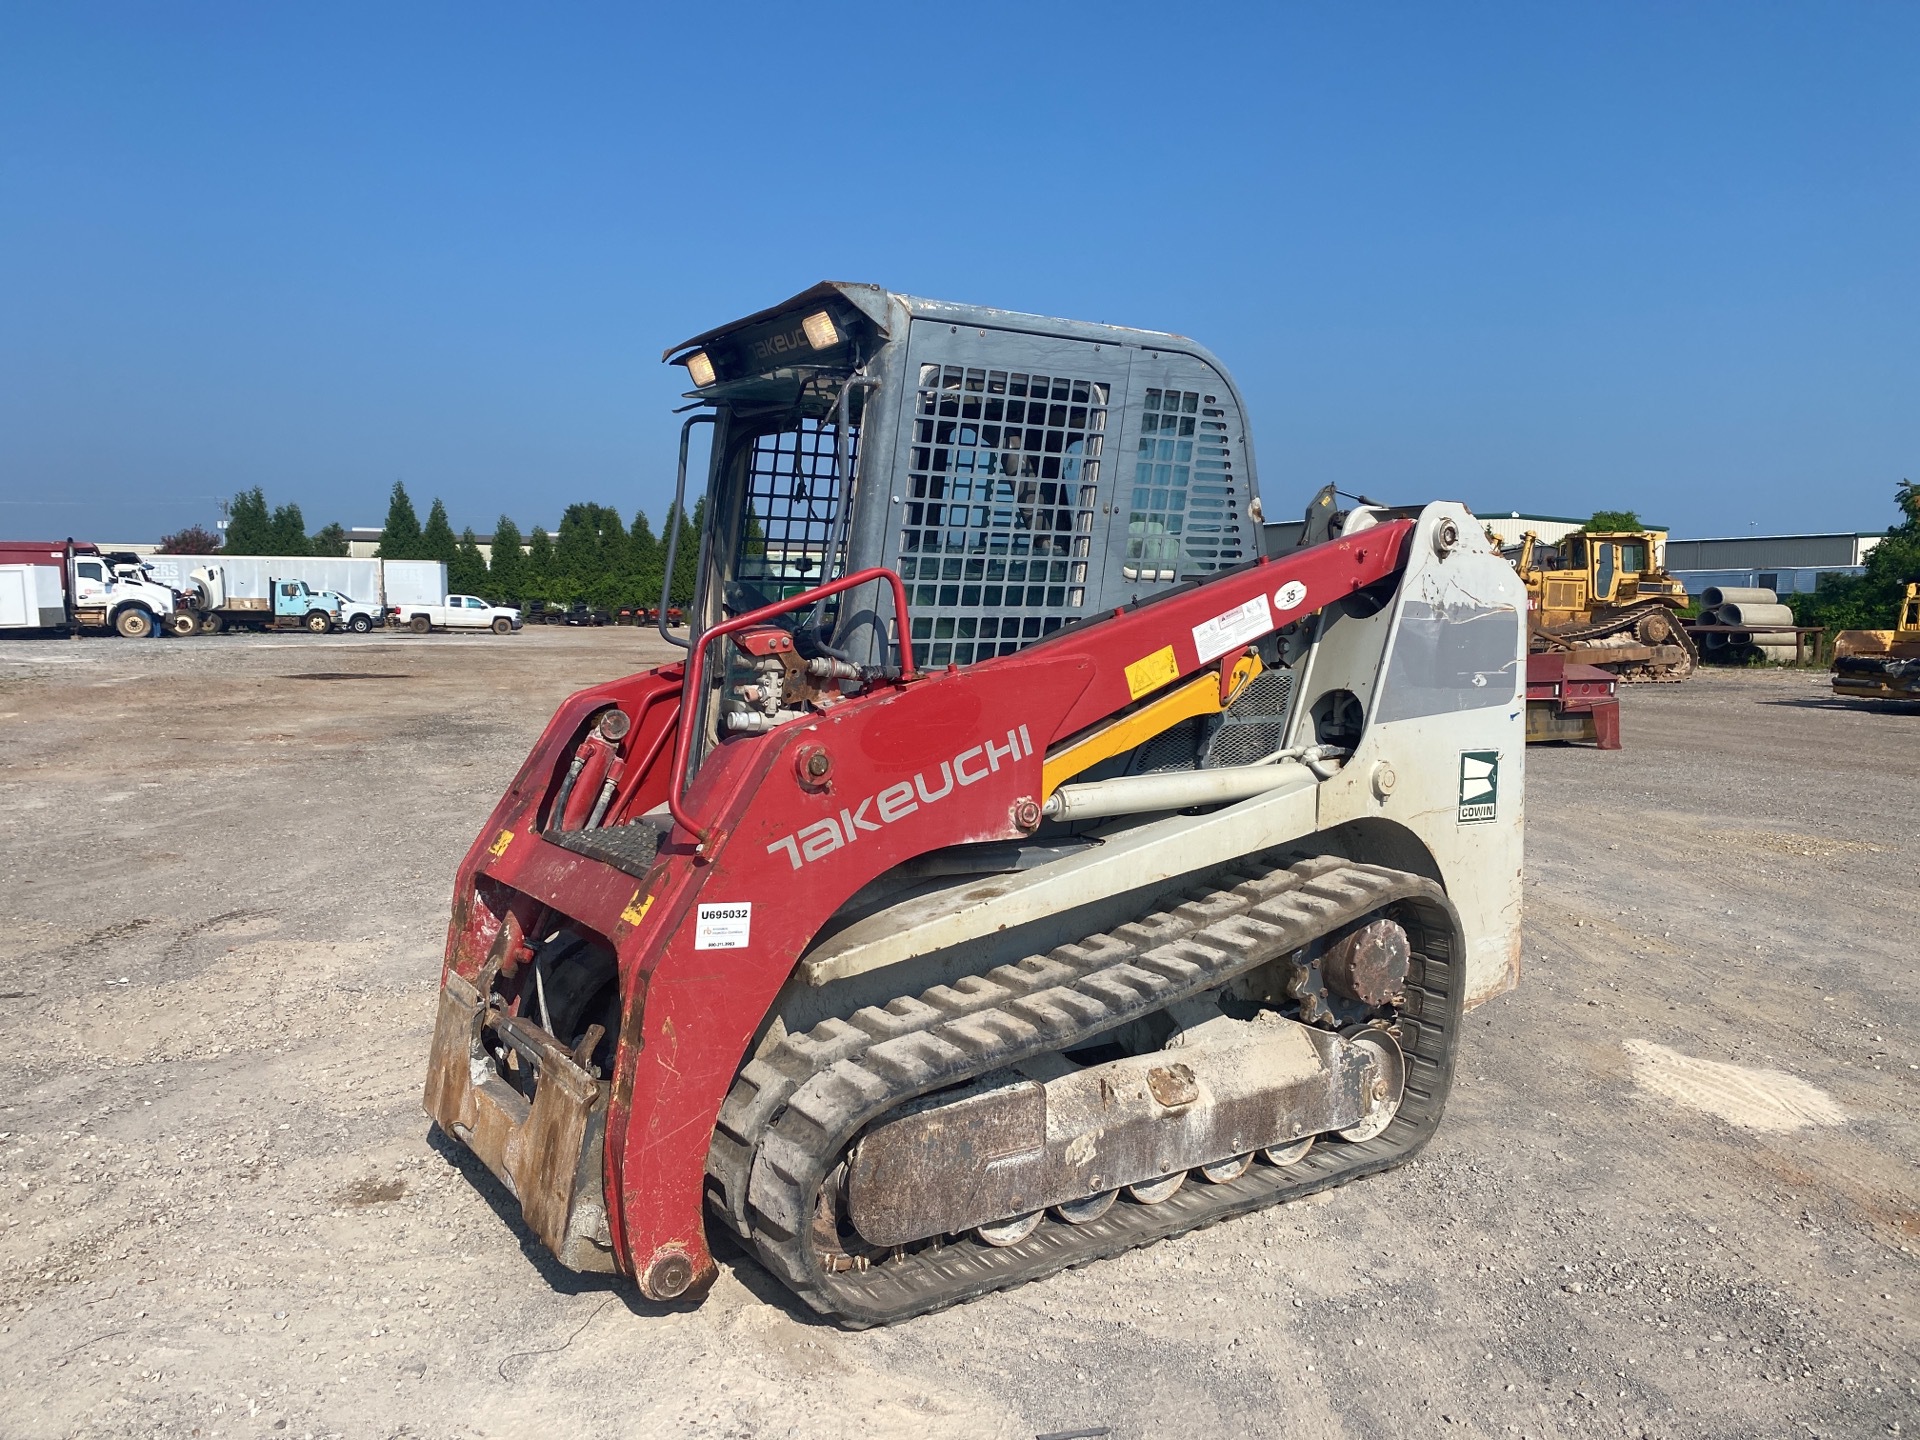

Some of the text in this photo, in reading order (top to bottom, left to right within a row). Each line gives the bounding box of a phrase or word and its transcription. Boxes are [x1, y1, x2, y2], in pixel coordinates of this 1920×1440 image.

[1286, 589, 1296, 603] 35
[766, 723, 1034, 871] TAKEUCHI
[1461, 805, 1493, 818] COWIN
[701, 909, 748, 920] U695032
